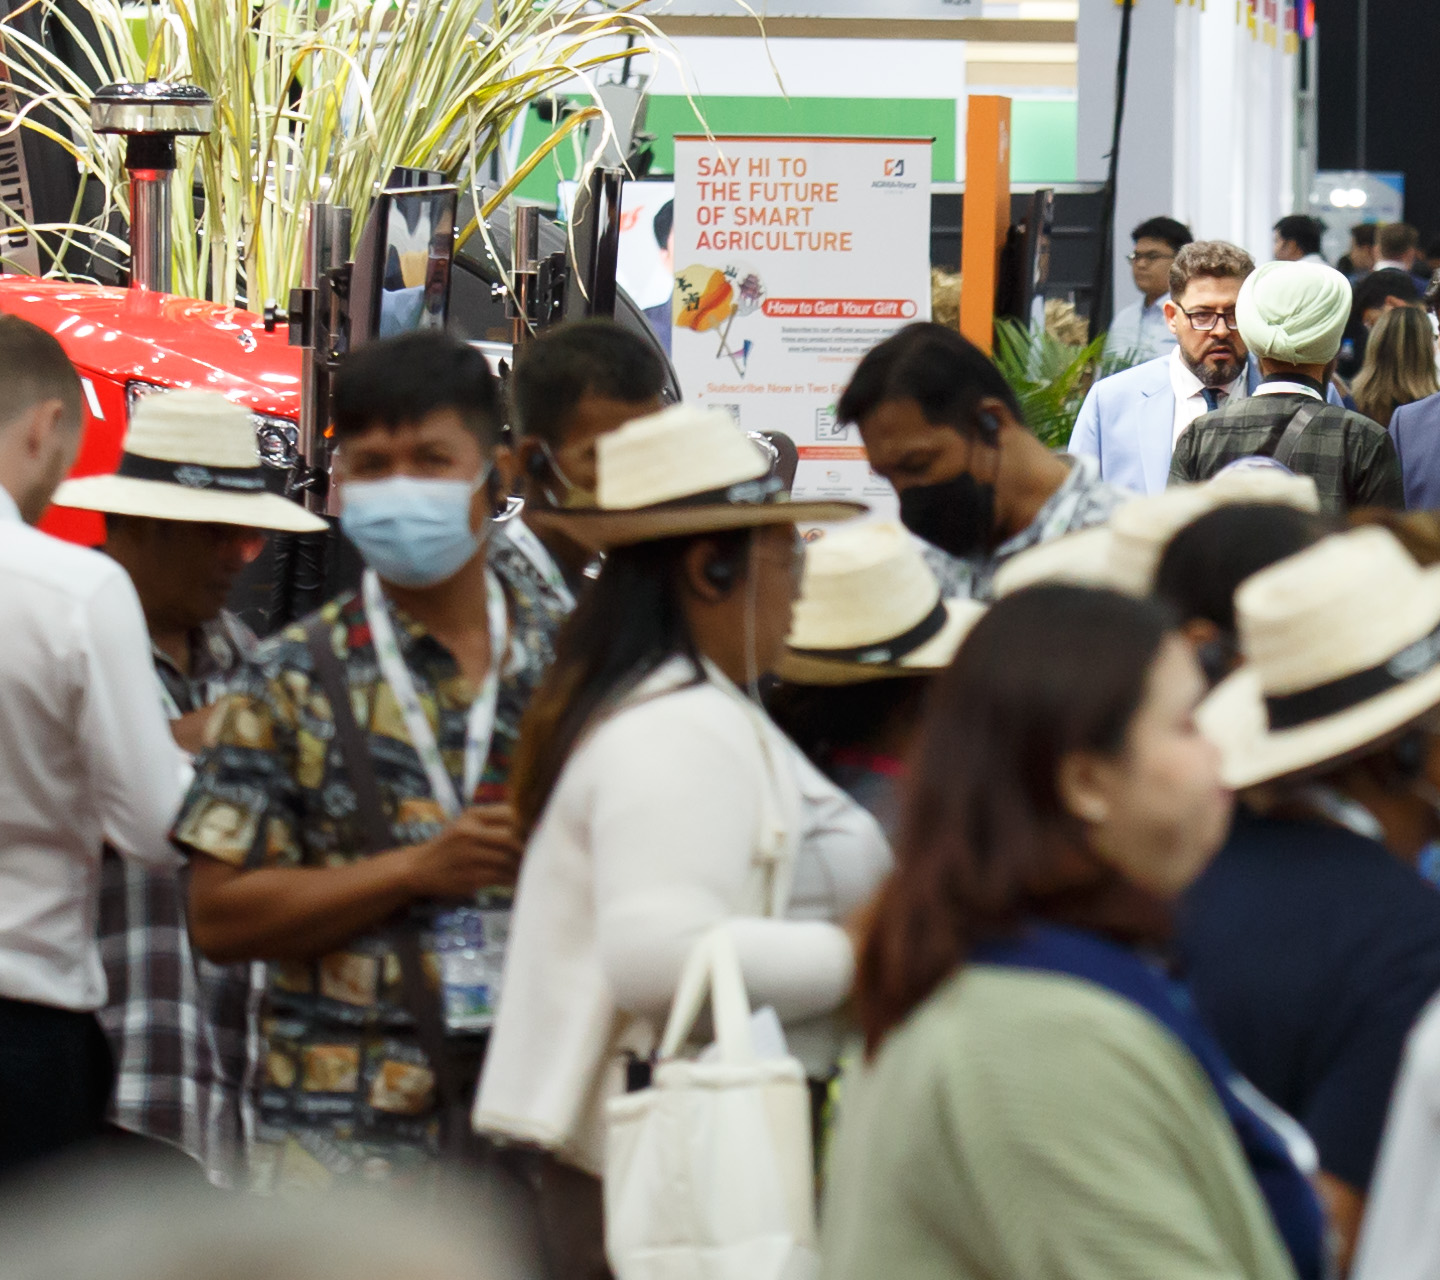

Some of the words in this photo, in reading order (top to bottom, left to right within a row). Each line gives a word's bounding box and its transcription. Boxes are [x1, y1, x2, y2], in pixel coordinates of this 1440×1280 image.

[697, 157, 741, 177] SAY
[748, 158, 770, 177] HI
[778, 158, 808, 178] TO
[697, 182, 741, 202] THE
[750, 183, 839, 203] FUTURE
[697, 206, 726, 226] OF
[734, 207, 814, 227] SMART
[696, 231, 853, 251] AGRICULTURE
[767, 301, 797, 315] How
[799, 301, 812, 315] to
[814, 301, 838, 315] Get
[842, 301, 872, 315] Your
[873, 302, 898, 316] Gift
[707, 383, 764, 394] Subscribe
[767, 384, 791, 394] Now
[795, 384, 804, 394] in
[809, 384, 829, 394] Two
